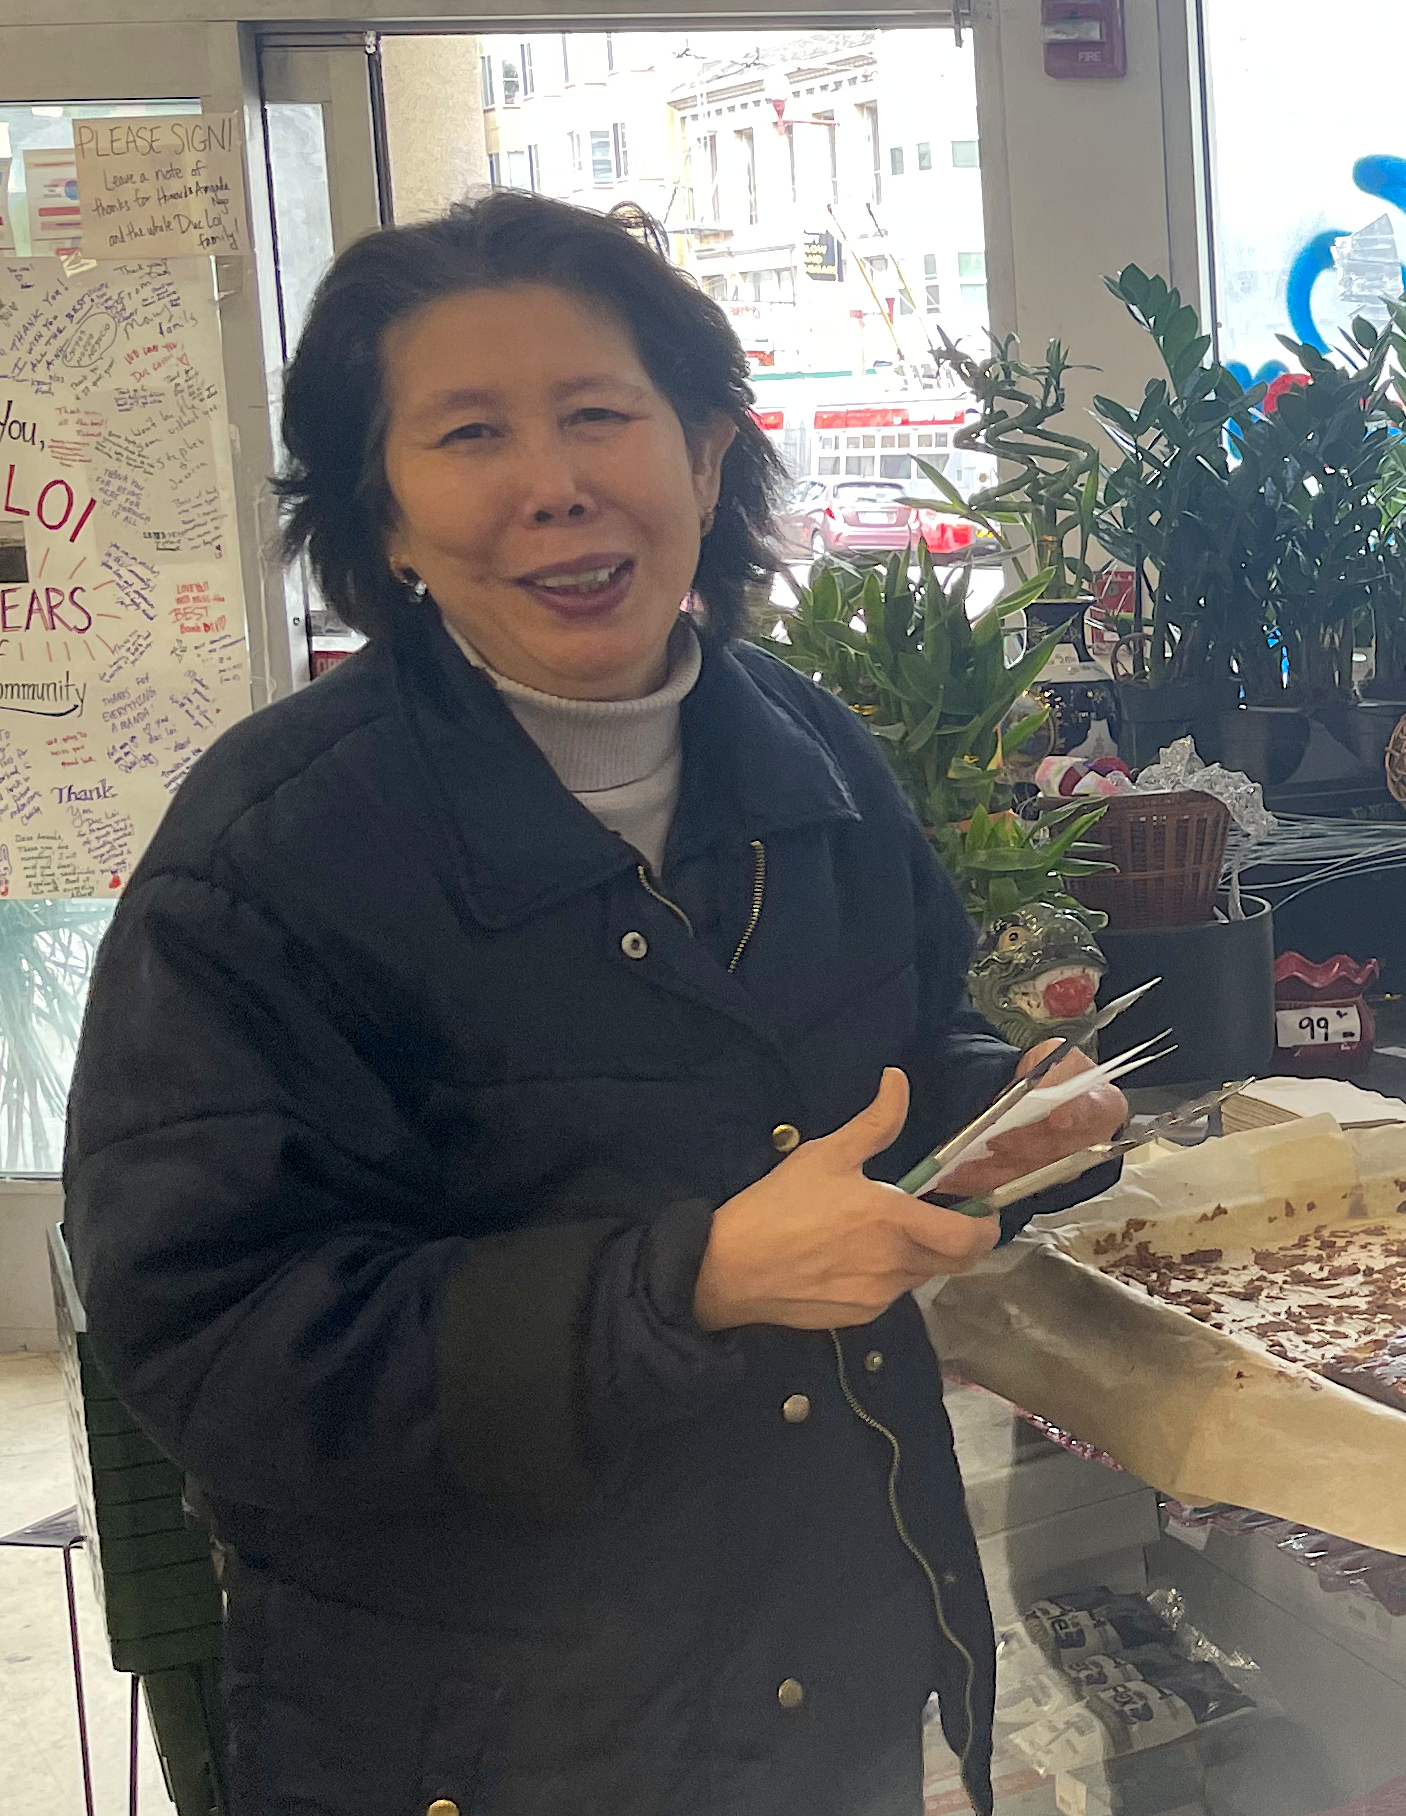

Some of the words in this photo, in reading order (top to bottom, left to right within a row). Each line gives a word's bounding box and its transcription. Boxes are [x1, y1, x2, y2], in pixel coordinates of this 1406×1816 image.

[1078, 51, 1102, 62] FIRE
[75, 125, 162, 159] PLEASE
[171, 118, 232, 155] SIGN!
[103, 167, 136, 191] Leave
[140, 173, 150, 184] a
[155, 162, 184, 181] note
[191, 160, 208, 177] of
[92, 198, 131, 218] thanks
[134, 189, 151, 208] for
[108, 225, 126, 247] and
[126, 222, 146, 241] the
[173, 213, 204, 235] Duc
[204, 209, 222, 229] Loi
[50, 778, 119, 804] Thank
